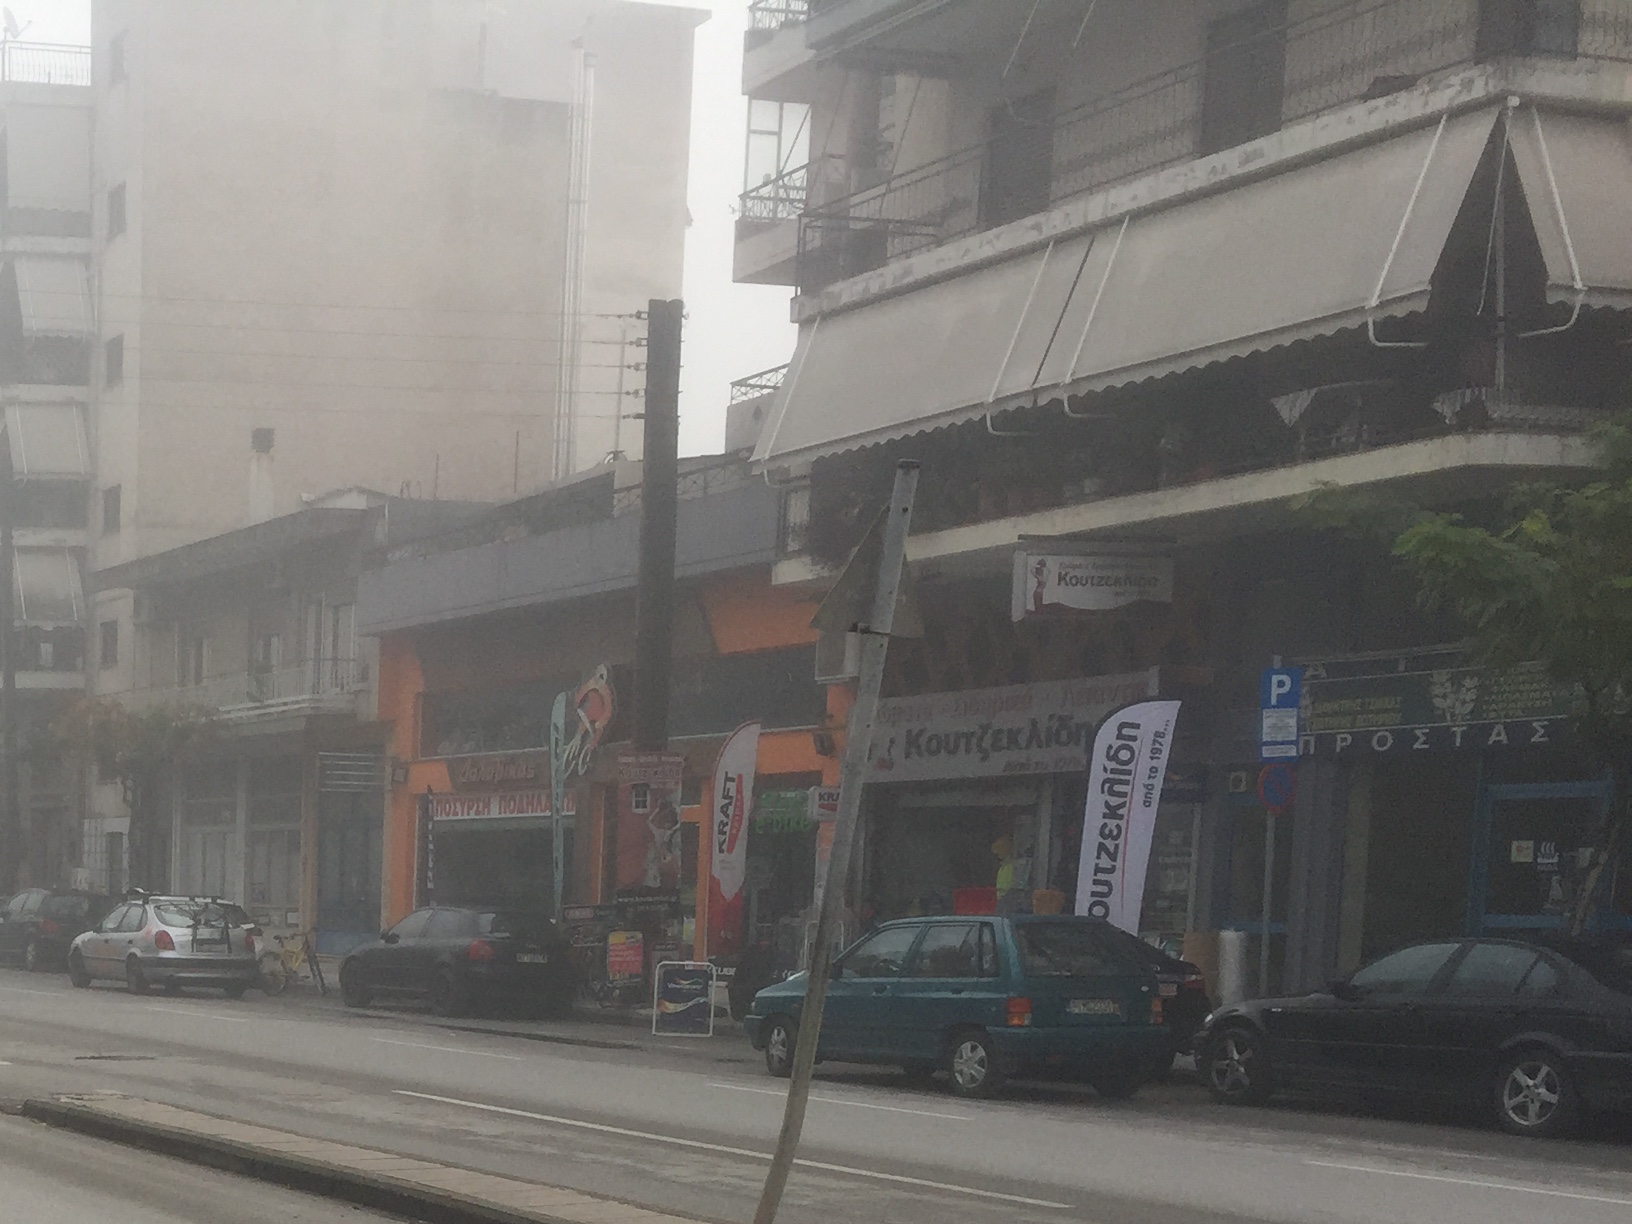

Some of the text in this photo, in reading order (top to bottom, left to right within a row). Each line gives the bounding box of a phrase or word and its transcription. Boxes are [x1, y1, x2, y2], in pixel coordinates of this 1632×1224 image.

[1271, 674, 1292, 706] P
[434, 796, 491, 818] ΠΟΣΥΡΣΗ
[718, 771, 736, 854] KRAFT
[1087, 721, 1142, 920] ουτζεκλίδη
